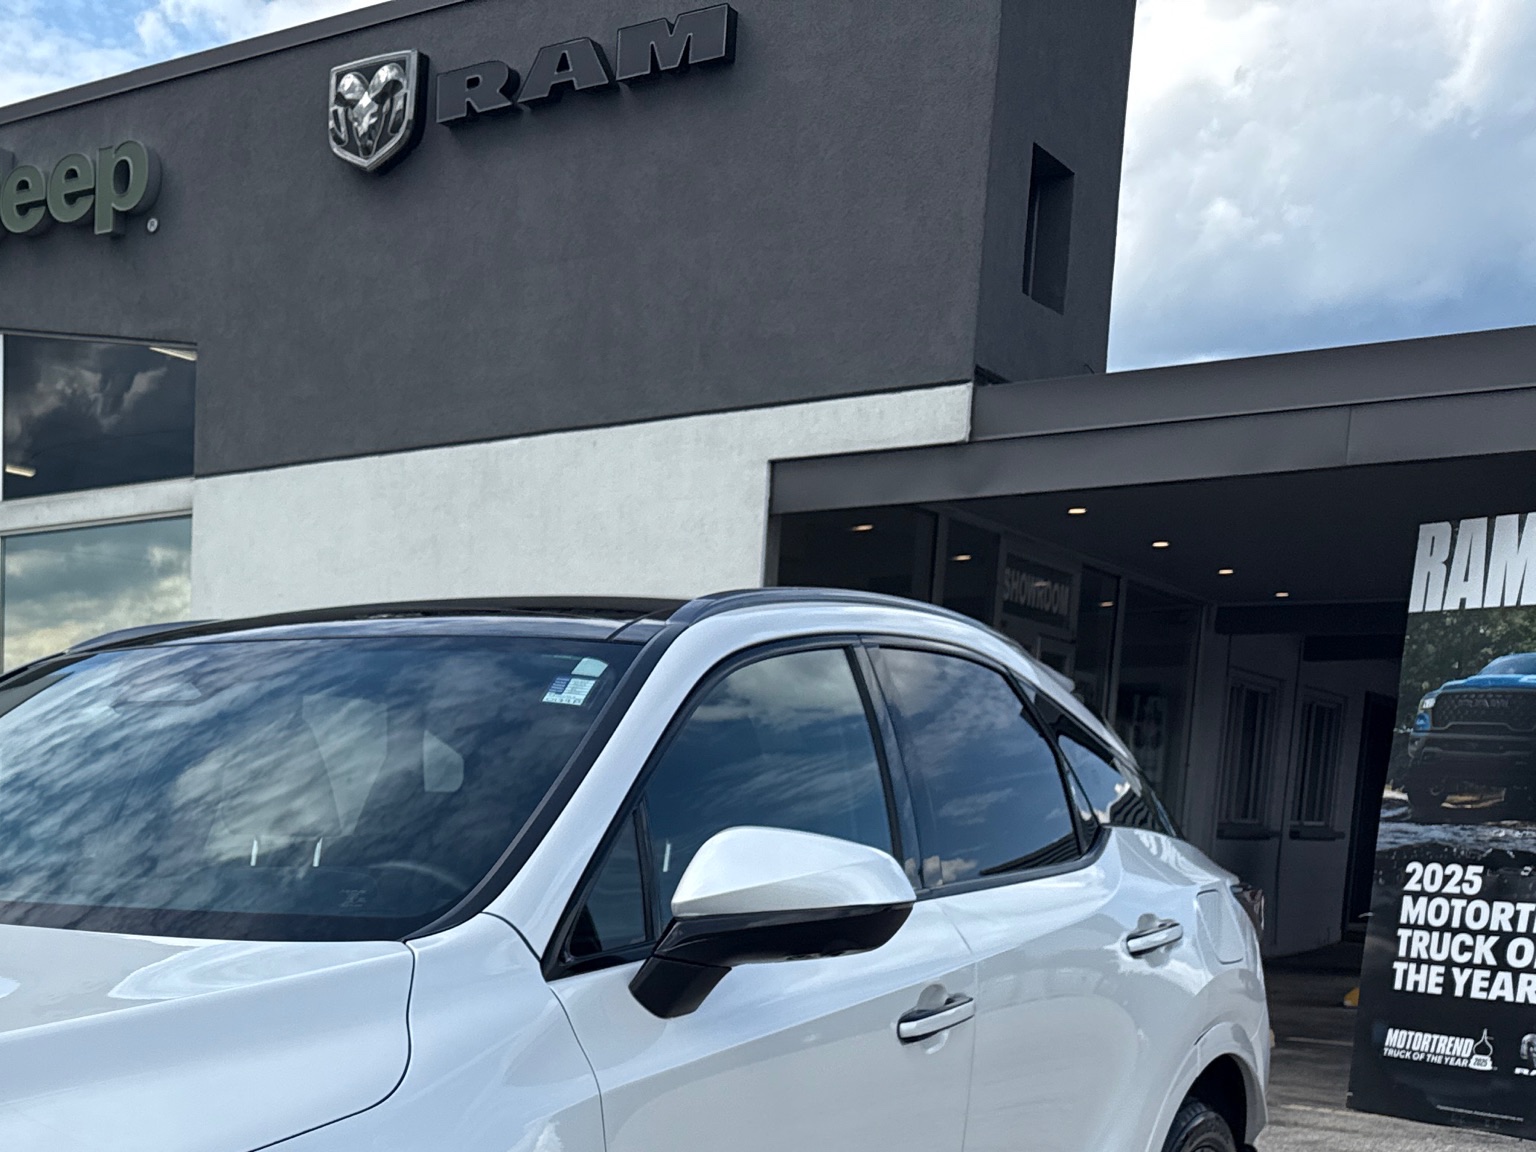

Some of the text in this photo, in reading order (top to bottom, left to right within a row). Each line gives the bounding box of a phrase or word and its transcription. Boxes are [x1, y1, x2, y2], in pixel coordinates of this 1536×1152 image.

[436, 4, 739, 125] RAM
[1408, 511, 1536, 613] RAM
[1402, 861, 1485, 896] 2025
[1399, 895, 1536, 934] MOTORT
[1396, 928, 1536, 969] TRUCK O
[1392, 961, 1536, 1005] THE YEAR
[1384, 1048, 1469, 1068] TRUCK OF THE YEAR
[1385, 1028, 1474, 1058] MOTORTREND
